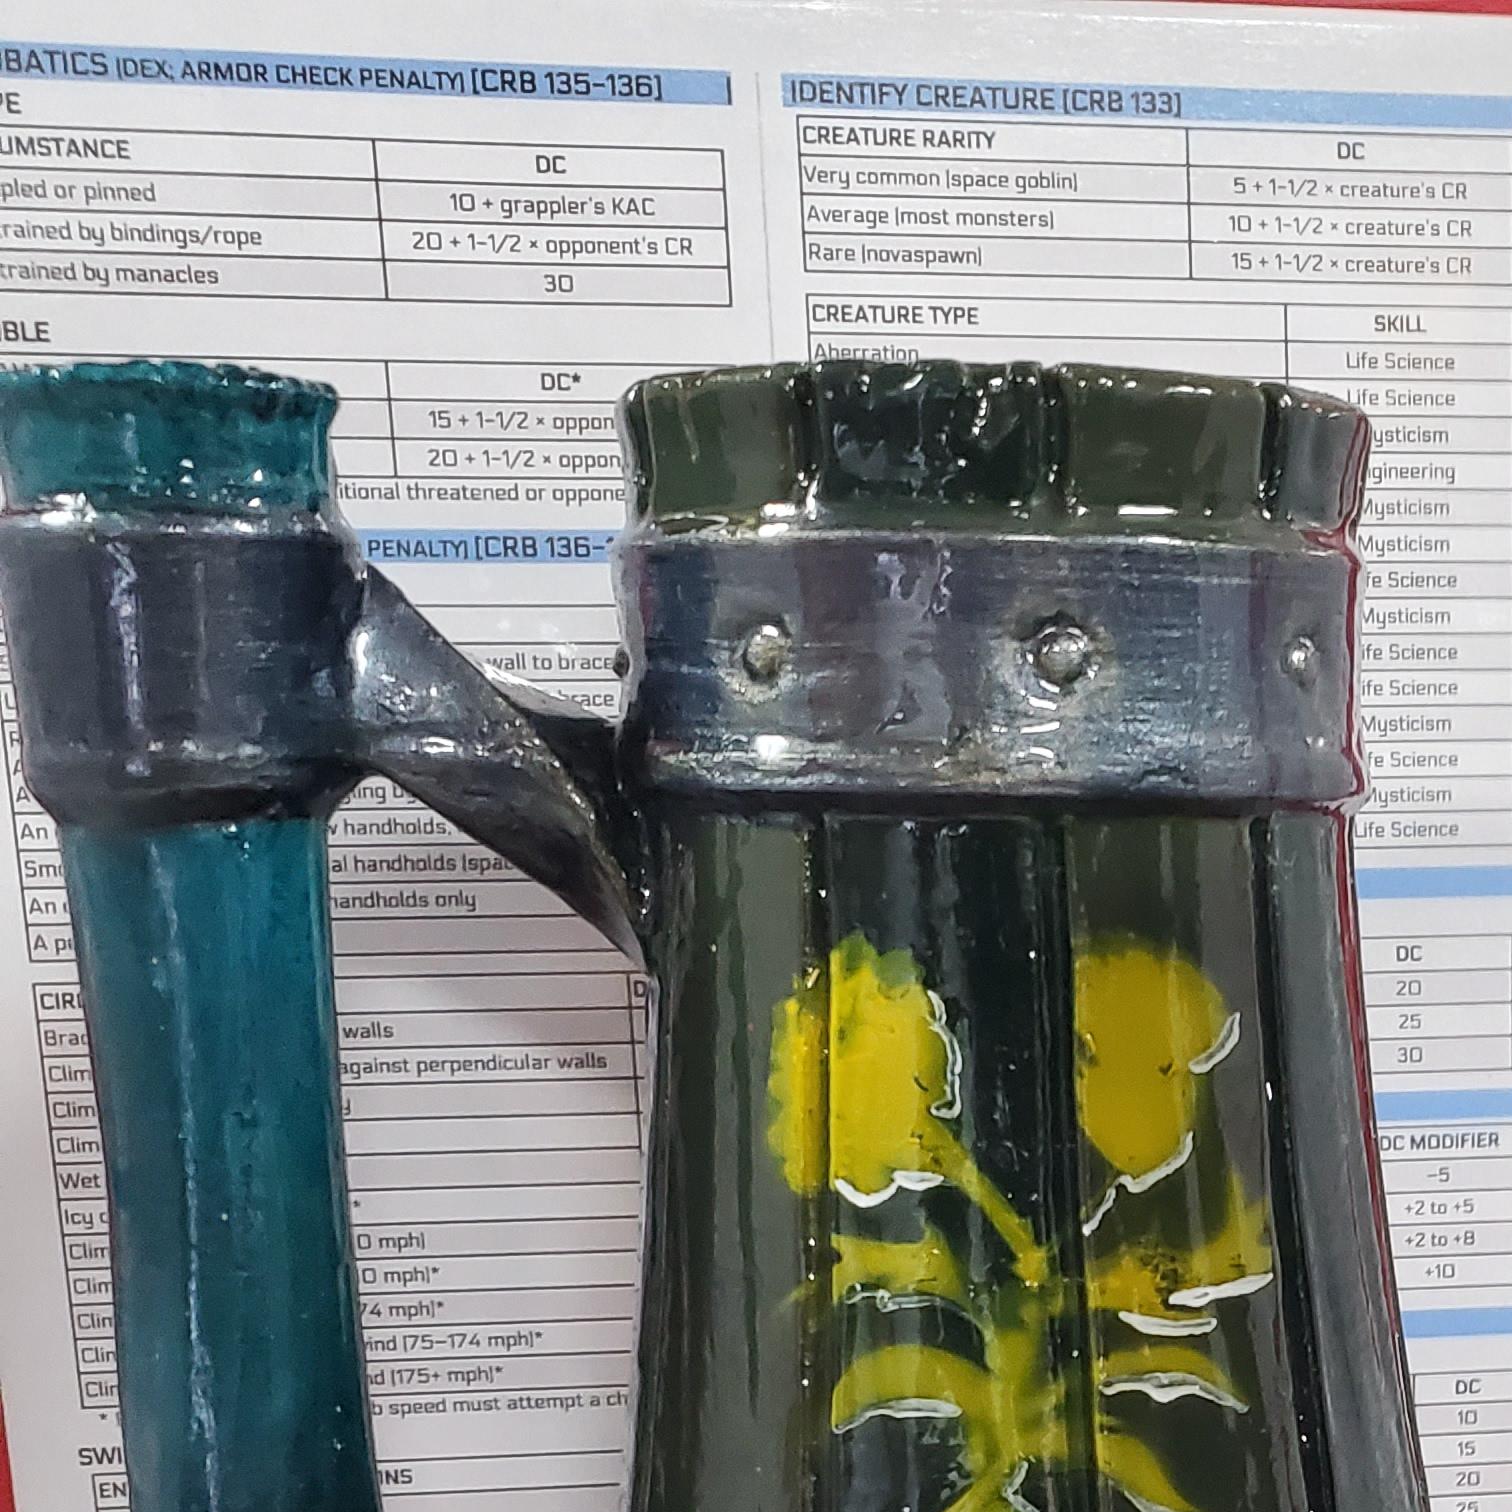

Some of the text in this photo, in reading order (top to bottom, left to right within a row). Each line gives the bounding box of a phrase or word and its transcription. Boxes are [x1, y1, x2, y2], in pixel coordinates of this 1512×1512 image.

[181, 60, 268, 83] ARMOR
[276, 64, 353, 87] CHECK
[791, 79, 908, 106] IDENTIFY
[916, 84, 1055, 111] CREATURE
[803, 125, 995, 149] CREATURE RARITY
[1338, 141, 1364, 160] DC
[536, 154, 566, 174] DC
[803, 163, 851, 192] Very
[856, 171, 940, 187] common
[84, 181, 156, 206] pinned
[1234, 177, 1246, 194] 5
[1340, 182, 1435, 198] creature's
[1442, 182, 1467, 200] CR
[450, 193, 655, 220] 10 grappler's KAC
[804, 204, 888, 232] Average
[110, 221, 262, 252] bindings/rope
[412, 231, 442, 250] 20
[546, 236, 658, 260] opponent's
[665, 237, 692, 256] CR
[806, 242, 855, 270] Rare
[1232, 252, 1252, 270] 15
[1346, 256, 1439, 274] creature's
[1447, 256, 1471, 274] CR
[116, 264, 218, 285] manacles
[544, 274, 573, 293] 30
[812, 304, 978, 325] CREATURE TYPE
[1375, 314, 1426, 333] SKILL
[1347, 352, 1455, 370] Life Science
[1347, 388, 1455, 407] Life Science
[1359, 534, 1450, 557] Mysticism
[1361, 714, 1451, 738] Mysticism
[344, 815, 454, 835] handholds,
[1354, 819, 1459, 838] Life Science
[1396, 944, 1422, 962] DC
[1396, 979, 1421, 996] 20
[343, 1021, 393, 1039] walls
[1399, 1013, 1421, 1029] 25
[416, 1051, 607, 1078] perpendicular walls
[1398, 1046, 1422, 1064] 30
[1380, 1131, 1499, 1152] DC MODIFIER
[1405, 1198, 1474, 1216] +2 to +5
[1426, 1263, 1455, 1279] +10
